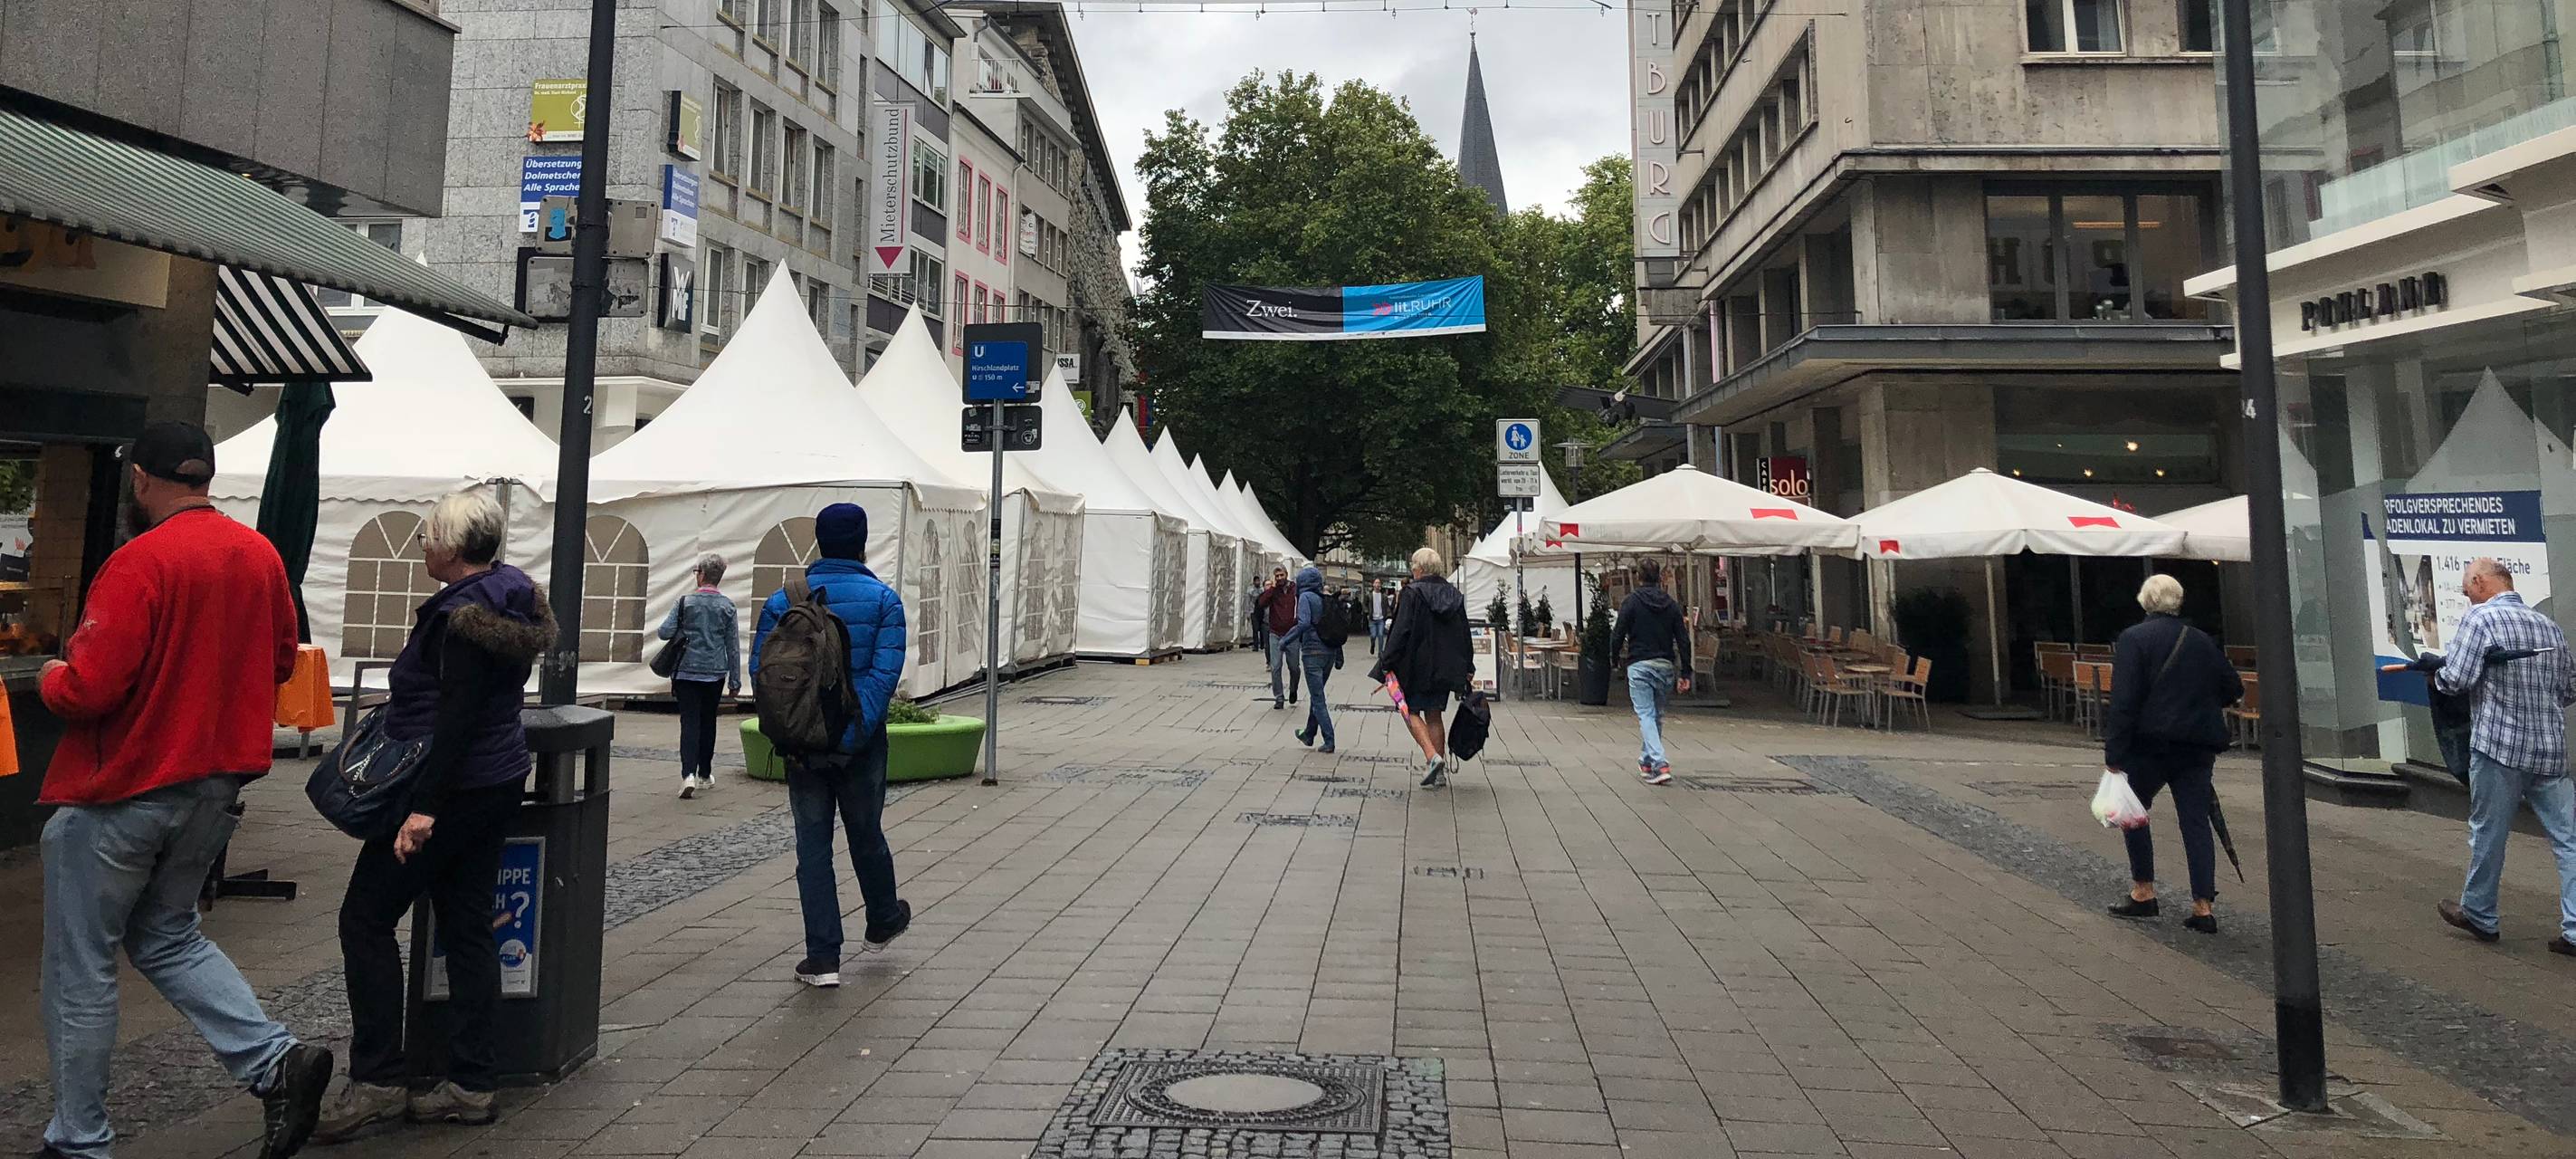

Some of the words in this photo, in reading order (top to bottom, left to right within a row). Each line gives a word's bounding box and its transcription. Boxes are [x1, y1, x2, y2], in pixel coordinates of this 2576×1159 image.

[880, 108, 900, 243] Mieterschutzbund
[523, 183, 542, 192] Alle
[1245, 299, 1298, 318] Zwei.
[2300, 272, 2447, 331] POHLAND
[974, 346, 985, 358] U
[971, 364, 1020, 372] Hirschlandplatz
[583, 395, 593, 415] 2
[1770, 469, 1808, 496] solo
[2386, 518, 2440, 535] ADENLOKAL
[2443, 518, 2456, 534] ZU
[2457, 518, 2516, 535] VERMIETEN
[2436, 555, 2460, 571] 1.416
